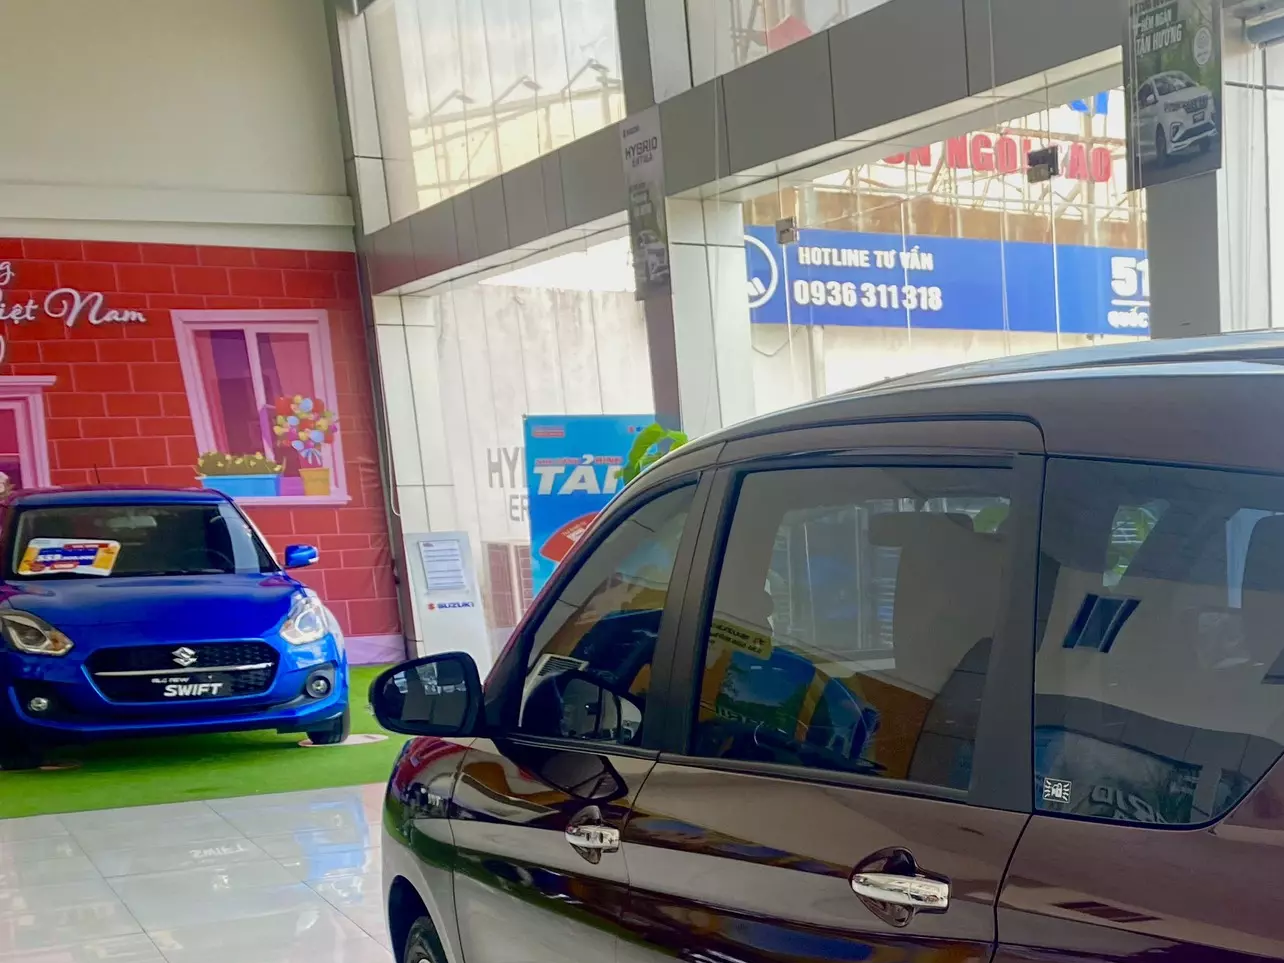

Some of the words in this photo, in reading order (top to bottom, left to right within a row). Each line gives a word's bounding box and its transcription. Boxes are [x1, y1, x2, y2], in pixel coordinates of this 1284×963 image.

[798, 246, 870, 268] HOTLINE
[874, 249, 896, 269] TƯ
[44, 287, 146, 327] Nam
[793, 279, 857, 307] 0936
[860, 282, 899, 309] 311
[901, 285, 943, 311] 318
[487, 446, 527, 489] HY
[163, 682, 223, 697] SWIFT
